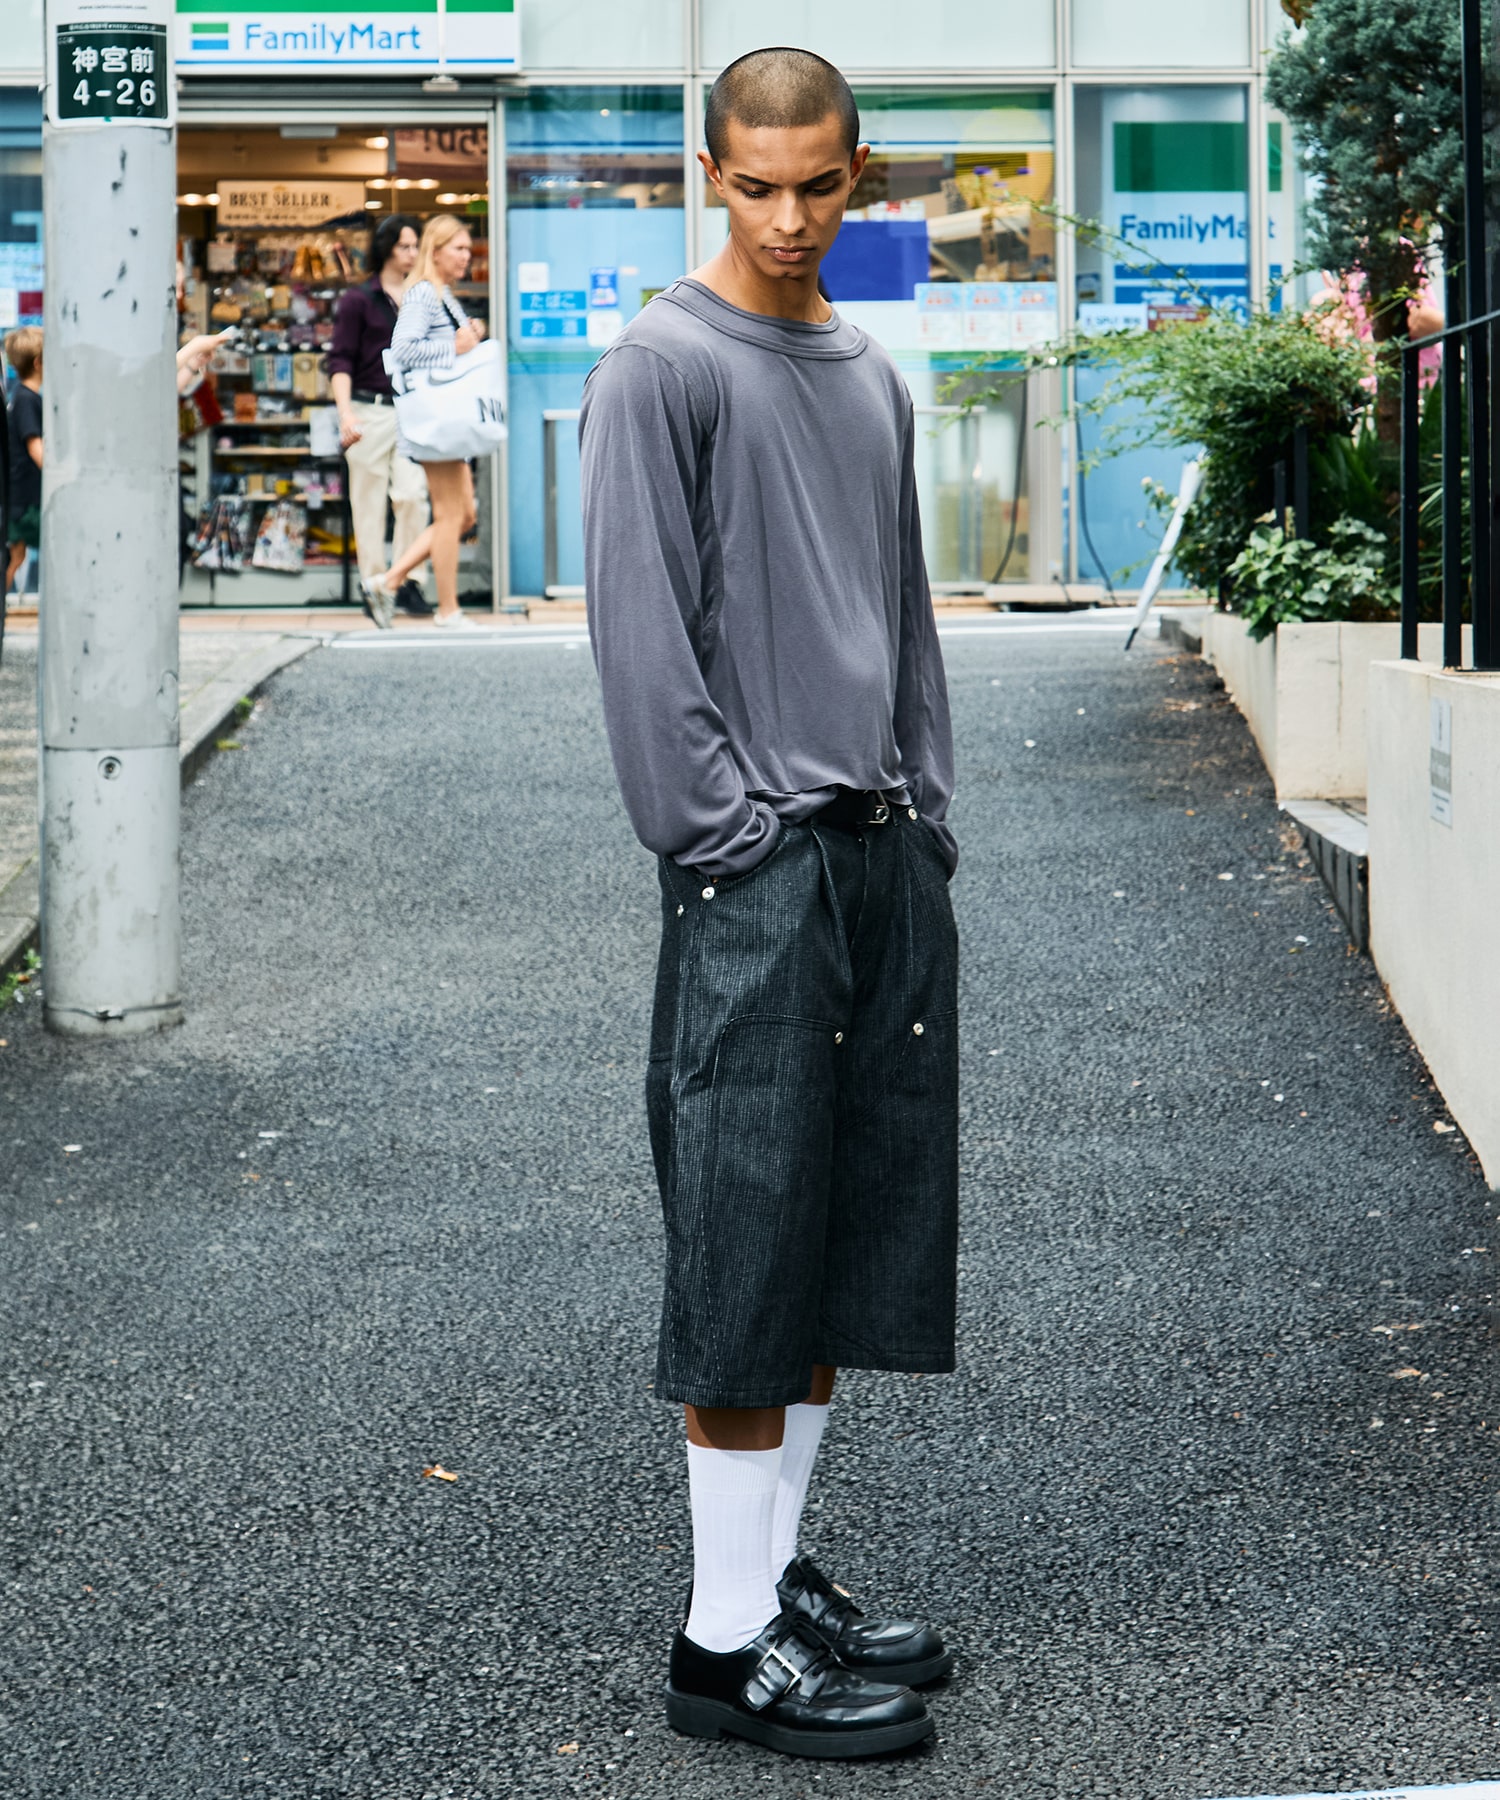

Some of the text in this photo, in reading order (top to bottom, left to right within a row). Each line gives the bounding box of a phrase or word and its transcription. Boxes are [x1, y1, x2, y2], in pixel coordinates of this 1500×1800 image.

[245, 23, 421, 54] FamilyMart
[72, 45, 155, 74] 神宮前
[73, 78, 156, 106] 4-26
[229, 192, 331, 207] BEST SELLER
[1120, 214, 1276, 243] FamilyMat
